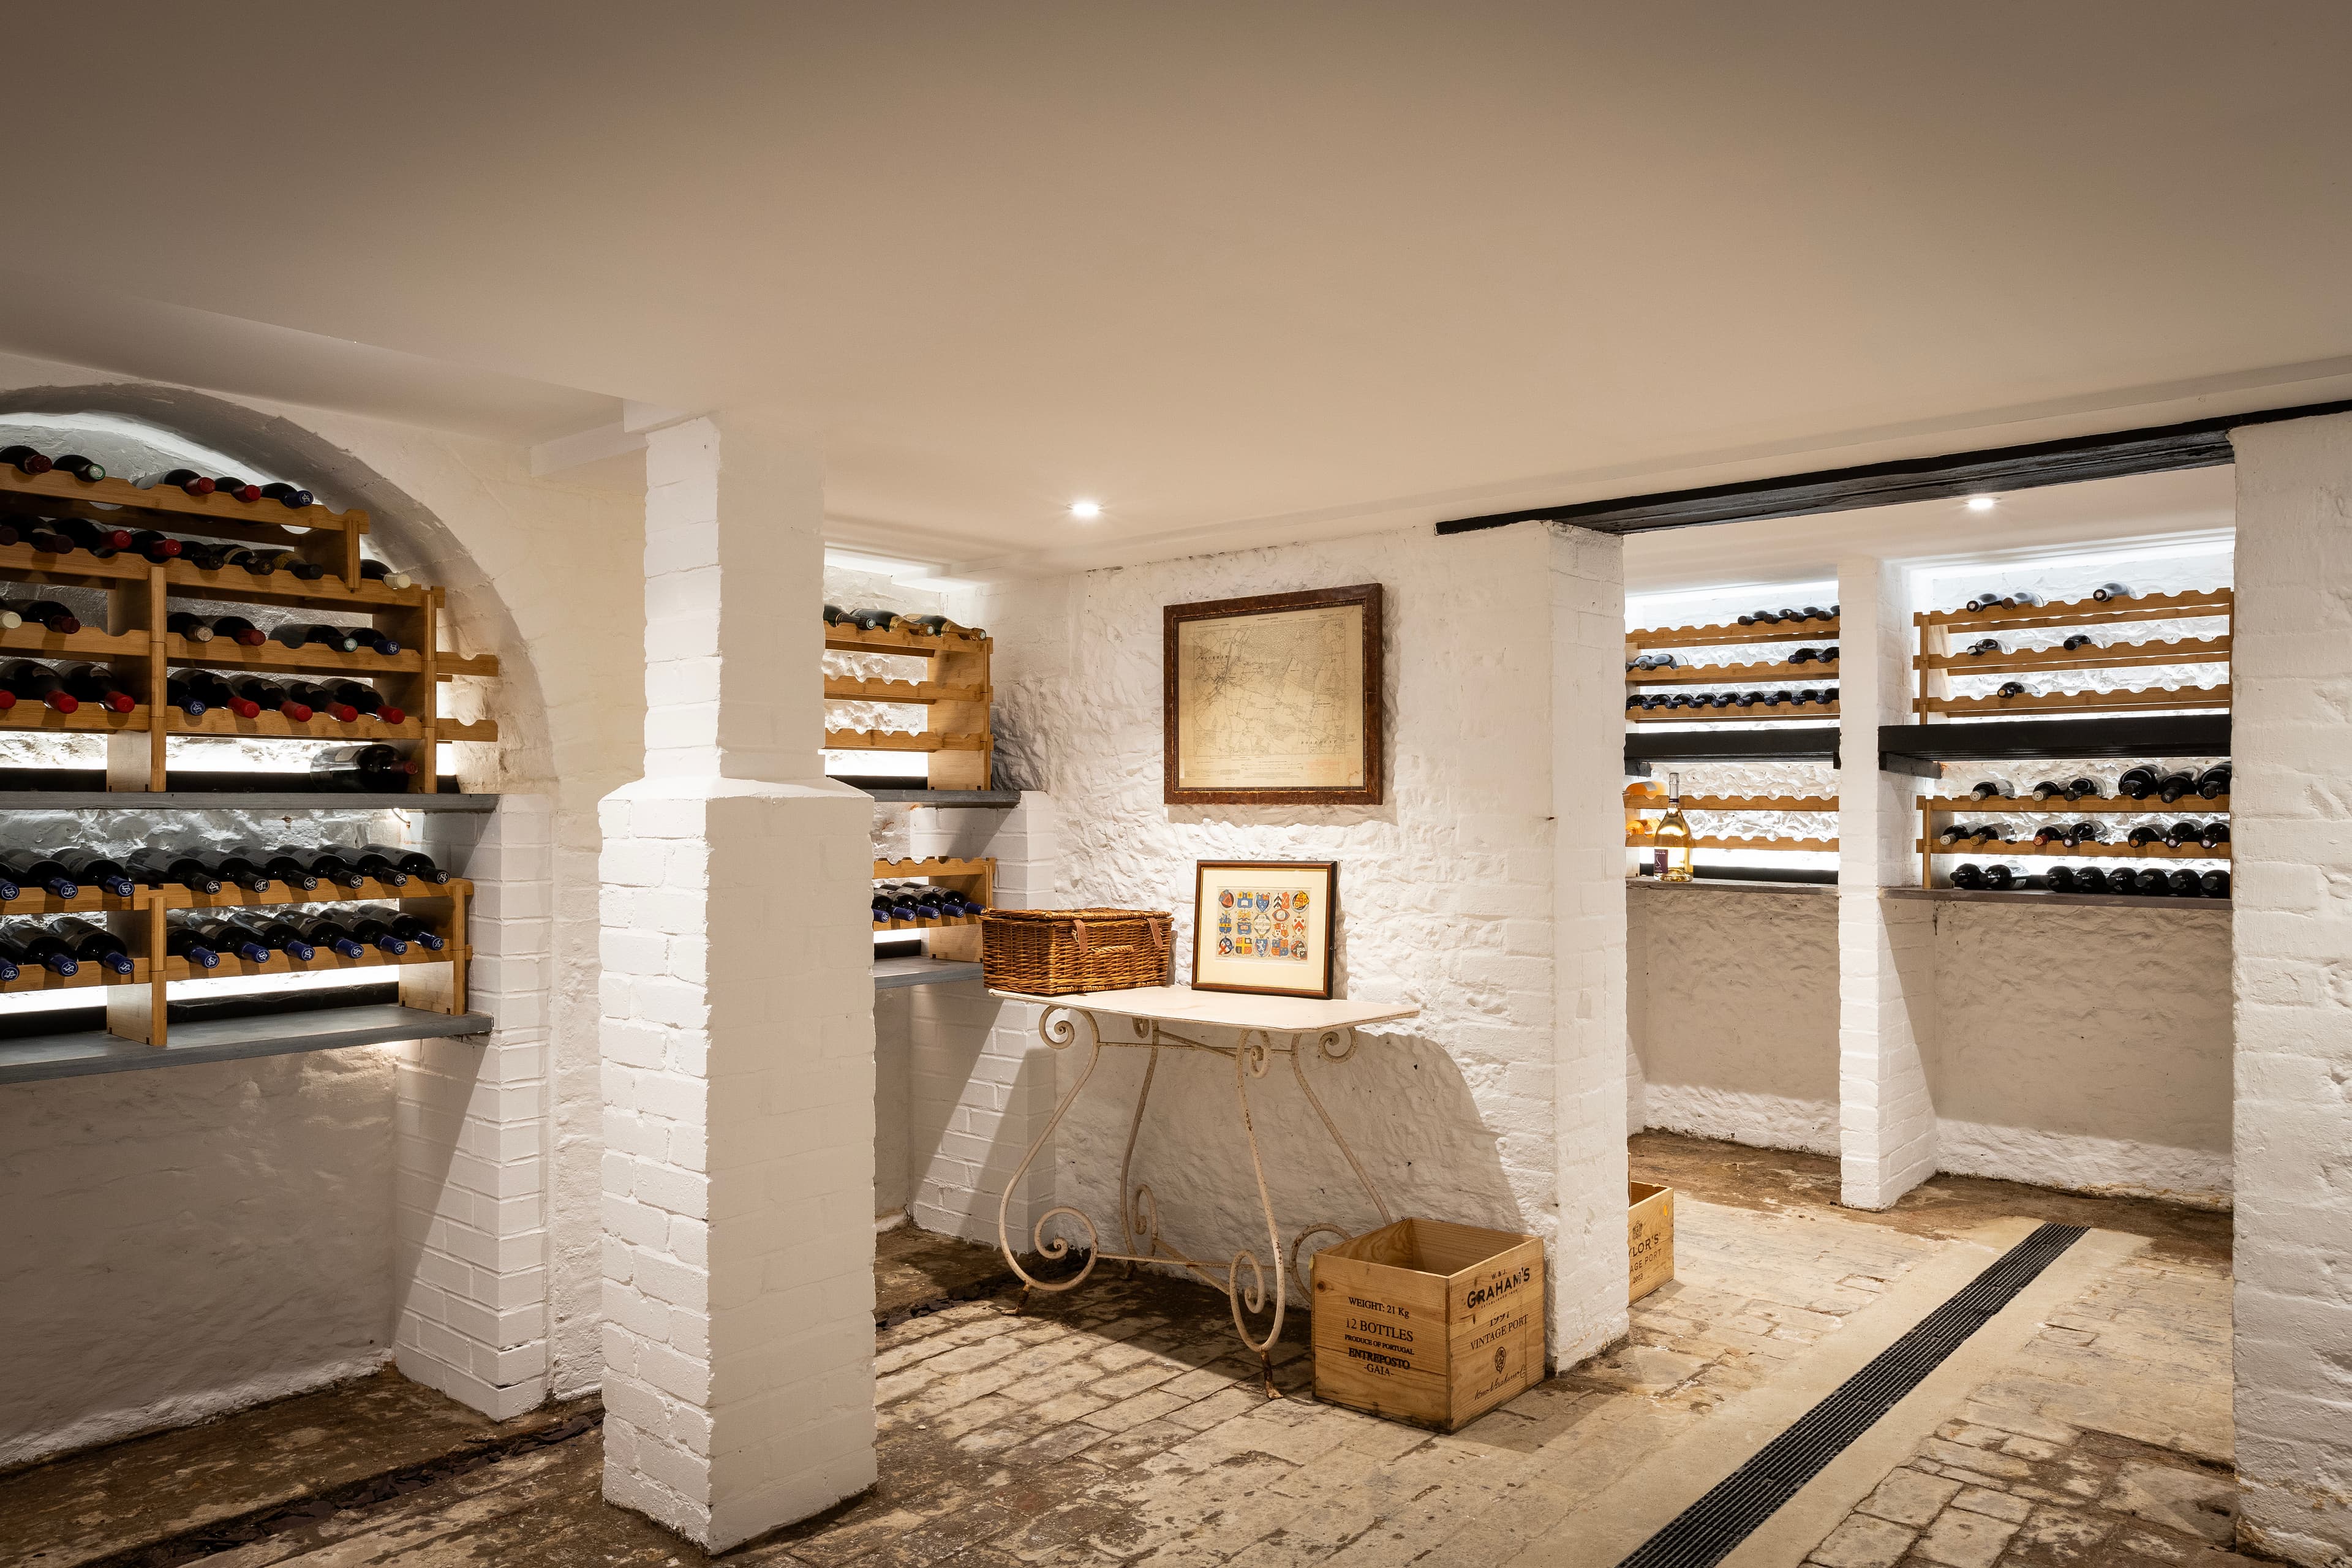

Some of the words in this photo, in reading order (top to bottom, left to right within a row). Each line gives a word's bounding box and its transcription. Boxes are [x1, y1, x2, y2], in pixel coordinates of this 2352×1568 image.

[1630, 1260, 1642, 1274] AGE
[1645, 1249, 1661, 1264] PORT
[1467, 1267, 1530, 1309] GRAHAM'S
[1348, 1296, 1385, 1312] WEIGHT:
[1387, 1305, 1395, 1314] 21
[1398, 1307, 1409, 1319] Kg
[1346, 1317, 1357, 1329] 12
[1360, 1320, 1414, 1342] BOTTLES
[1471, 1325, 1507, 1350] VINTAGE
[1508, 1314, 1529, 1332] PORT
[1344, 1334, 1372, 1346] PRODUCE
[1382, 1343, 1414, 1355] PORTUGAL
[1348, 1348, 1411, 1370] ENTREPOSTO
